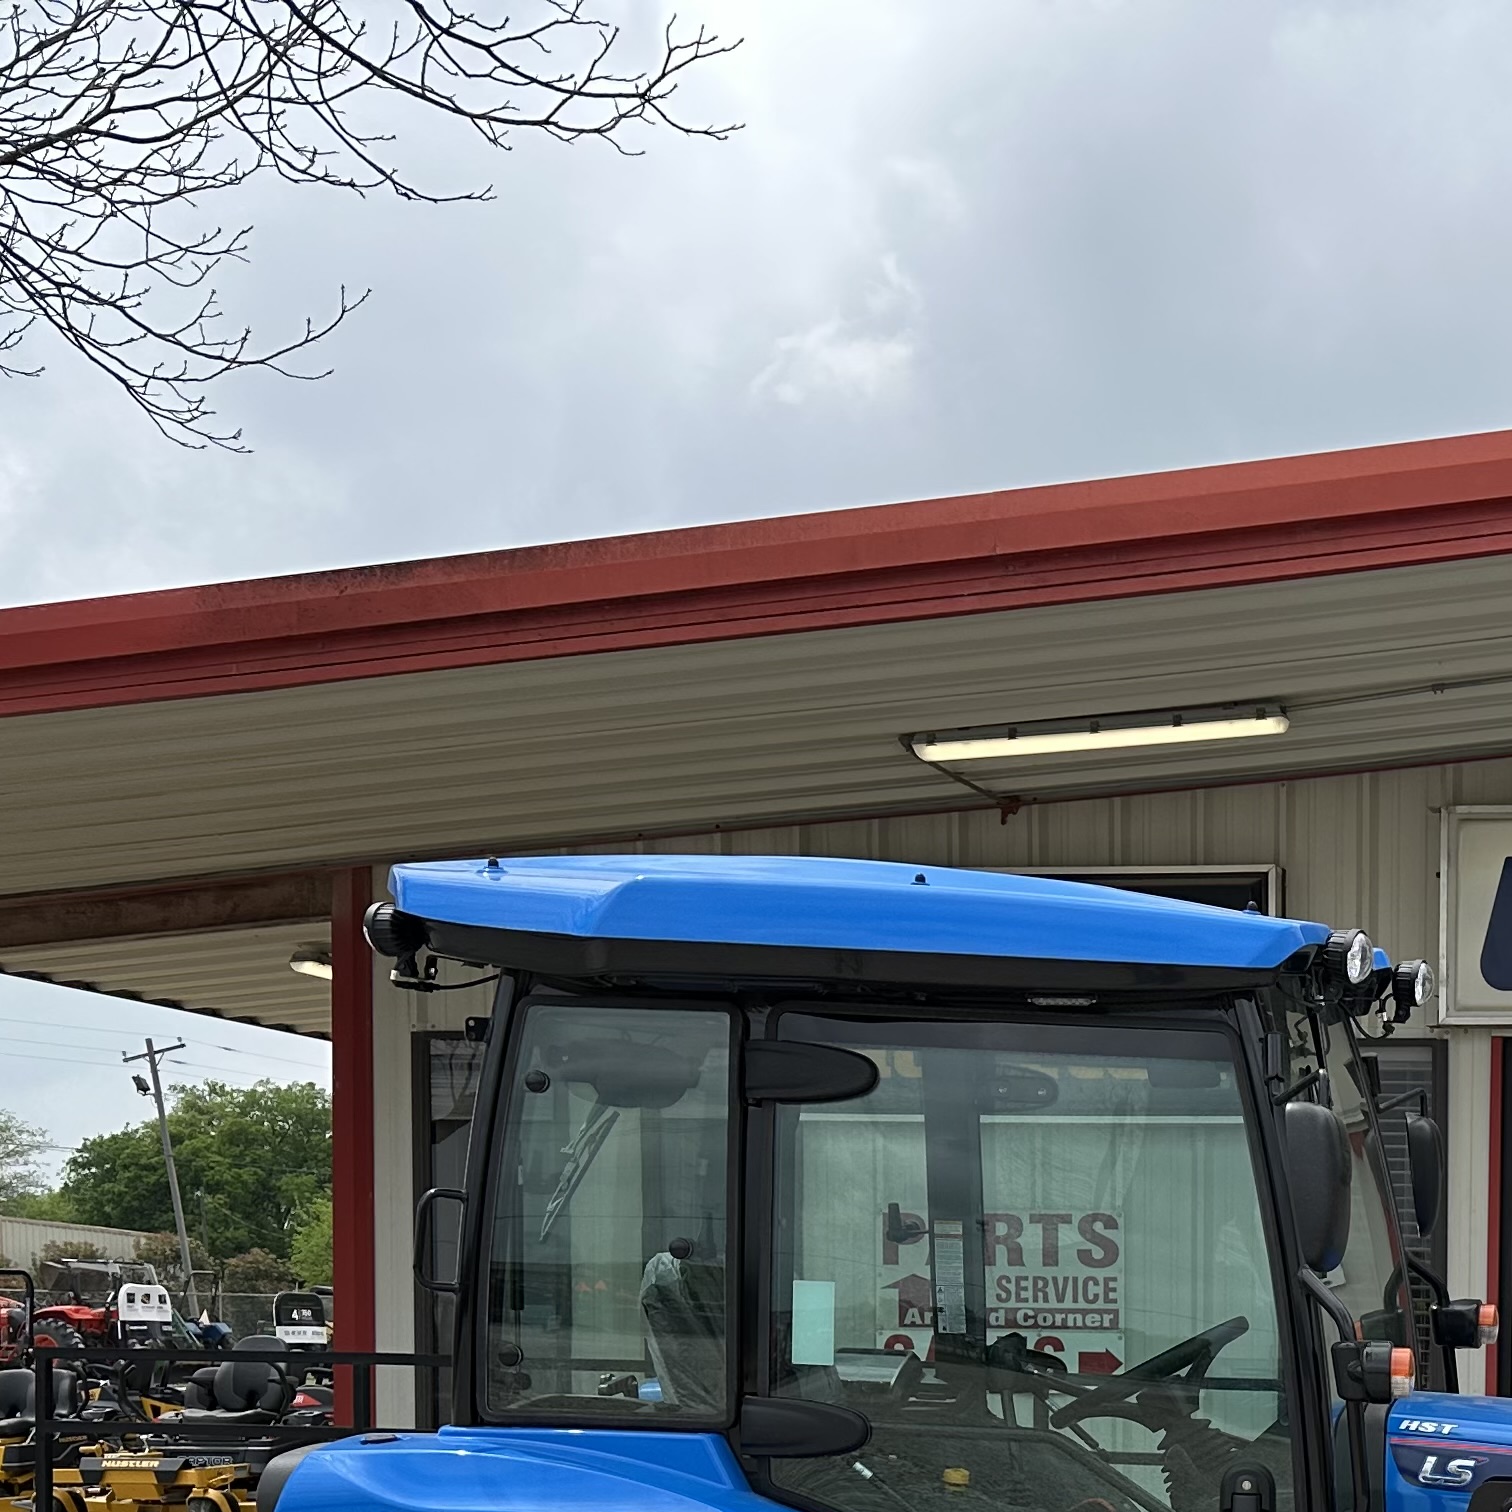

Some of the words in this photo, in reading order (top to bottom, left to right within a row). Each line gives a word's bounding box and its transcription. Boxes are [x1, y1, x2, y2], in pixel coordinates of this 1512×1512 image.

[882, 1212, 1121, 1269] PRTS
[995, 1274, 1119, 1305] SERVICE
[903, 1307, 1006, 1327] Ard
[1016, 1308, 1115, 1328] Corner
[1399, 1419, 1459, 1435] HST
[1418, 1455, 1476, 1486] LS
